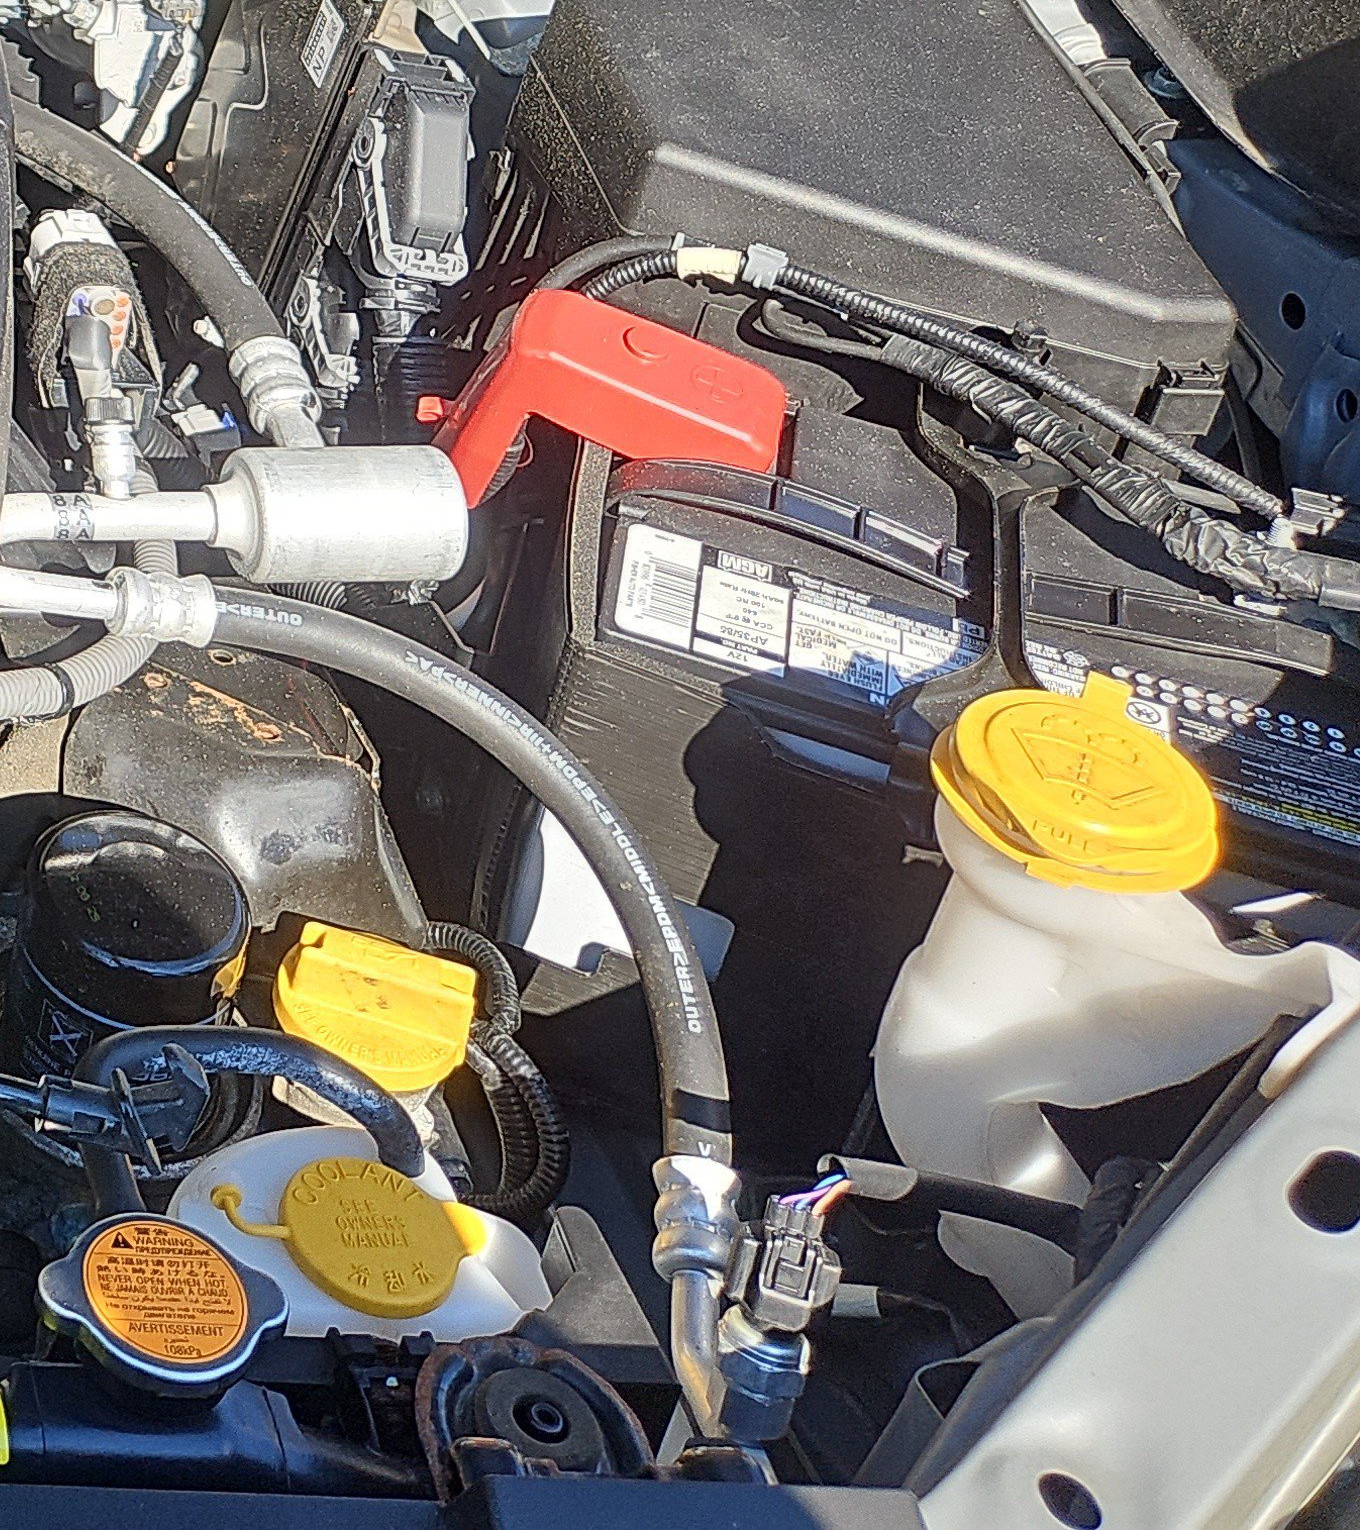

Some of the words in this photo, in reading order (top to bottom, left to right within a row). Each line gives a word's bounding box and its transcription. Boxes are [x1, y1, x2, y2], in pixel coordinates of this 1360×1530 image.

[721, 550, 770, 579] AGM
[752, 620, 774, 631] CCA
[794, 632, 837, 649] MEDICAL
[795, 640, 813, 650] GET
[726, 649, 749, 662] 12V
[292, 1159, 426, 1205] COOLANT
[133, 1235, 194, 1248] WARNING
[97, 1273, 132, 1284] NEVER
[136, 1276, 165, 1286] OPEN
[168, 1277, 201, 1288] WHEN
[115, 1284, 148, 1294] JAMAIS
[151, 1285, 185, 1296] OUVRIR
[128, 1321, 224, 1337] AVERTISSEMENT
